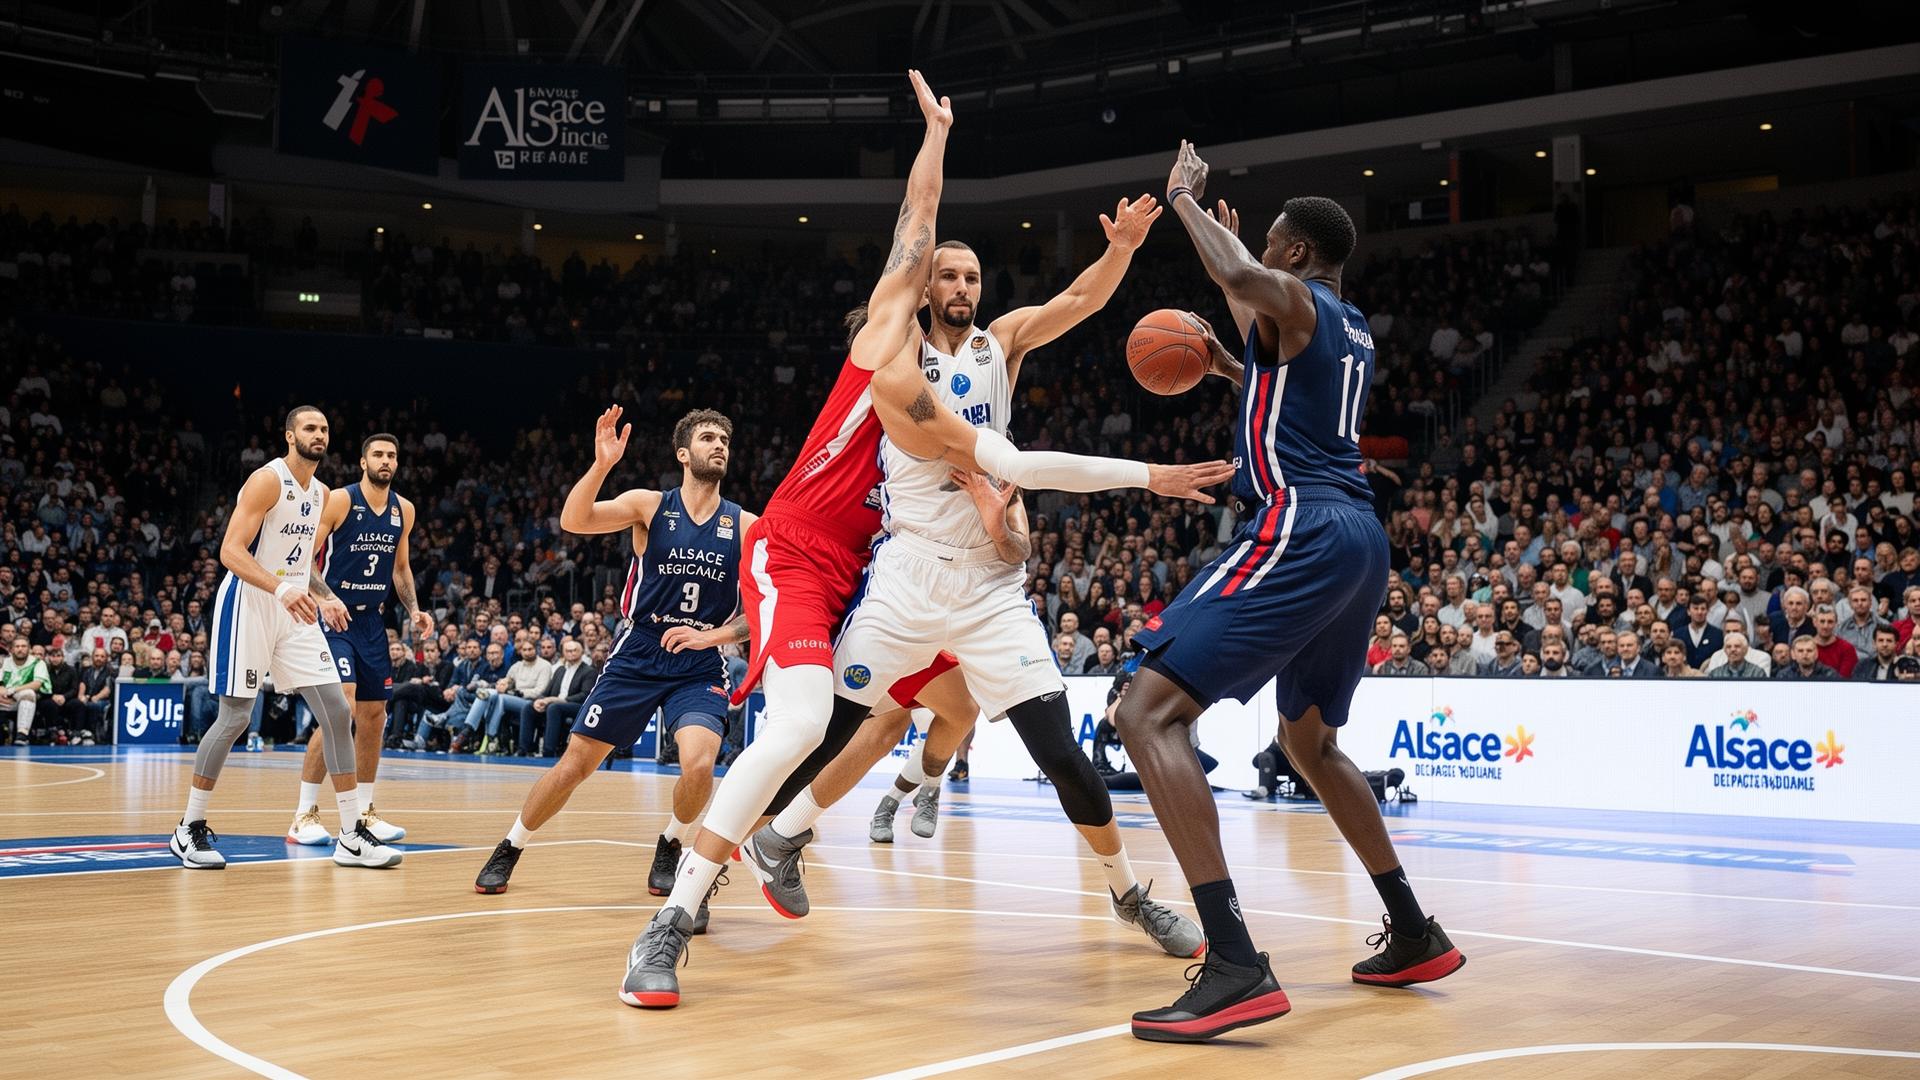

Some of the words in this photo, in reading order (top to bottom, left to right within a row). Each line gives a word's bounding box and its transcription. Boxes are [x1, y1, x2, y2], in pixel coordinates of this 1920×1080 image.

[463, 86, 607, 148] Alsace
[356, 533, 395, 544] ALSACE
[363, 553, 379, 577] 3
[668, 547, 725, 566] ALSACE
[584, 704, 602, 728] 6
[1389, 719, 1501, 762] Alsace
[1685, 724, 1812, 771] Alsace
